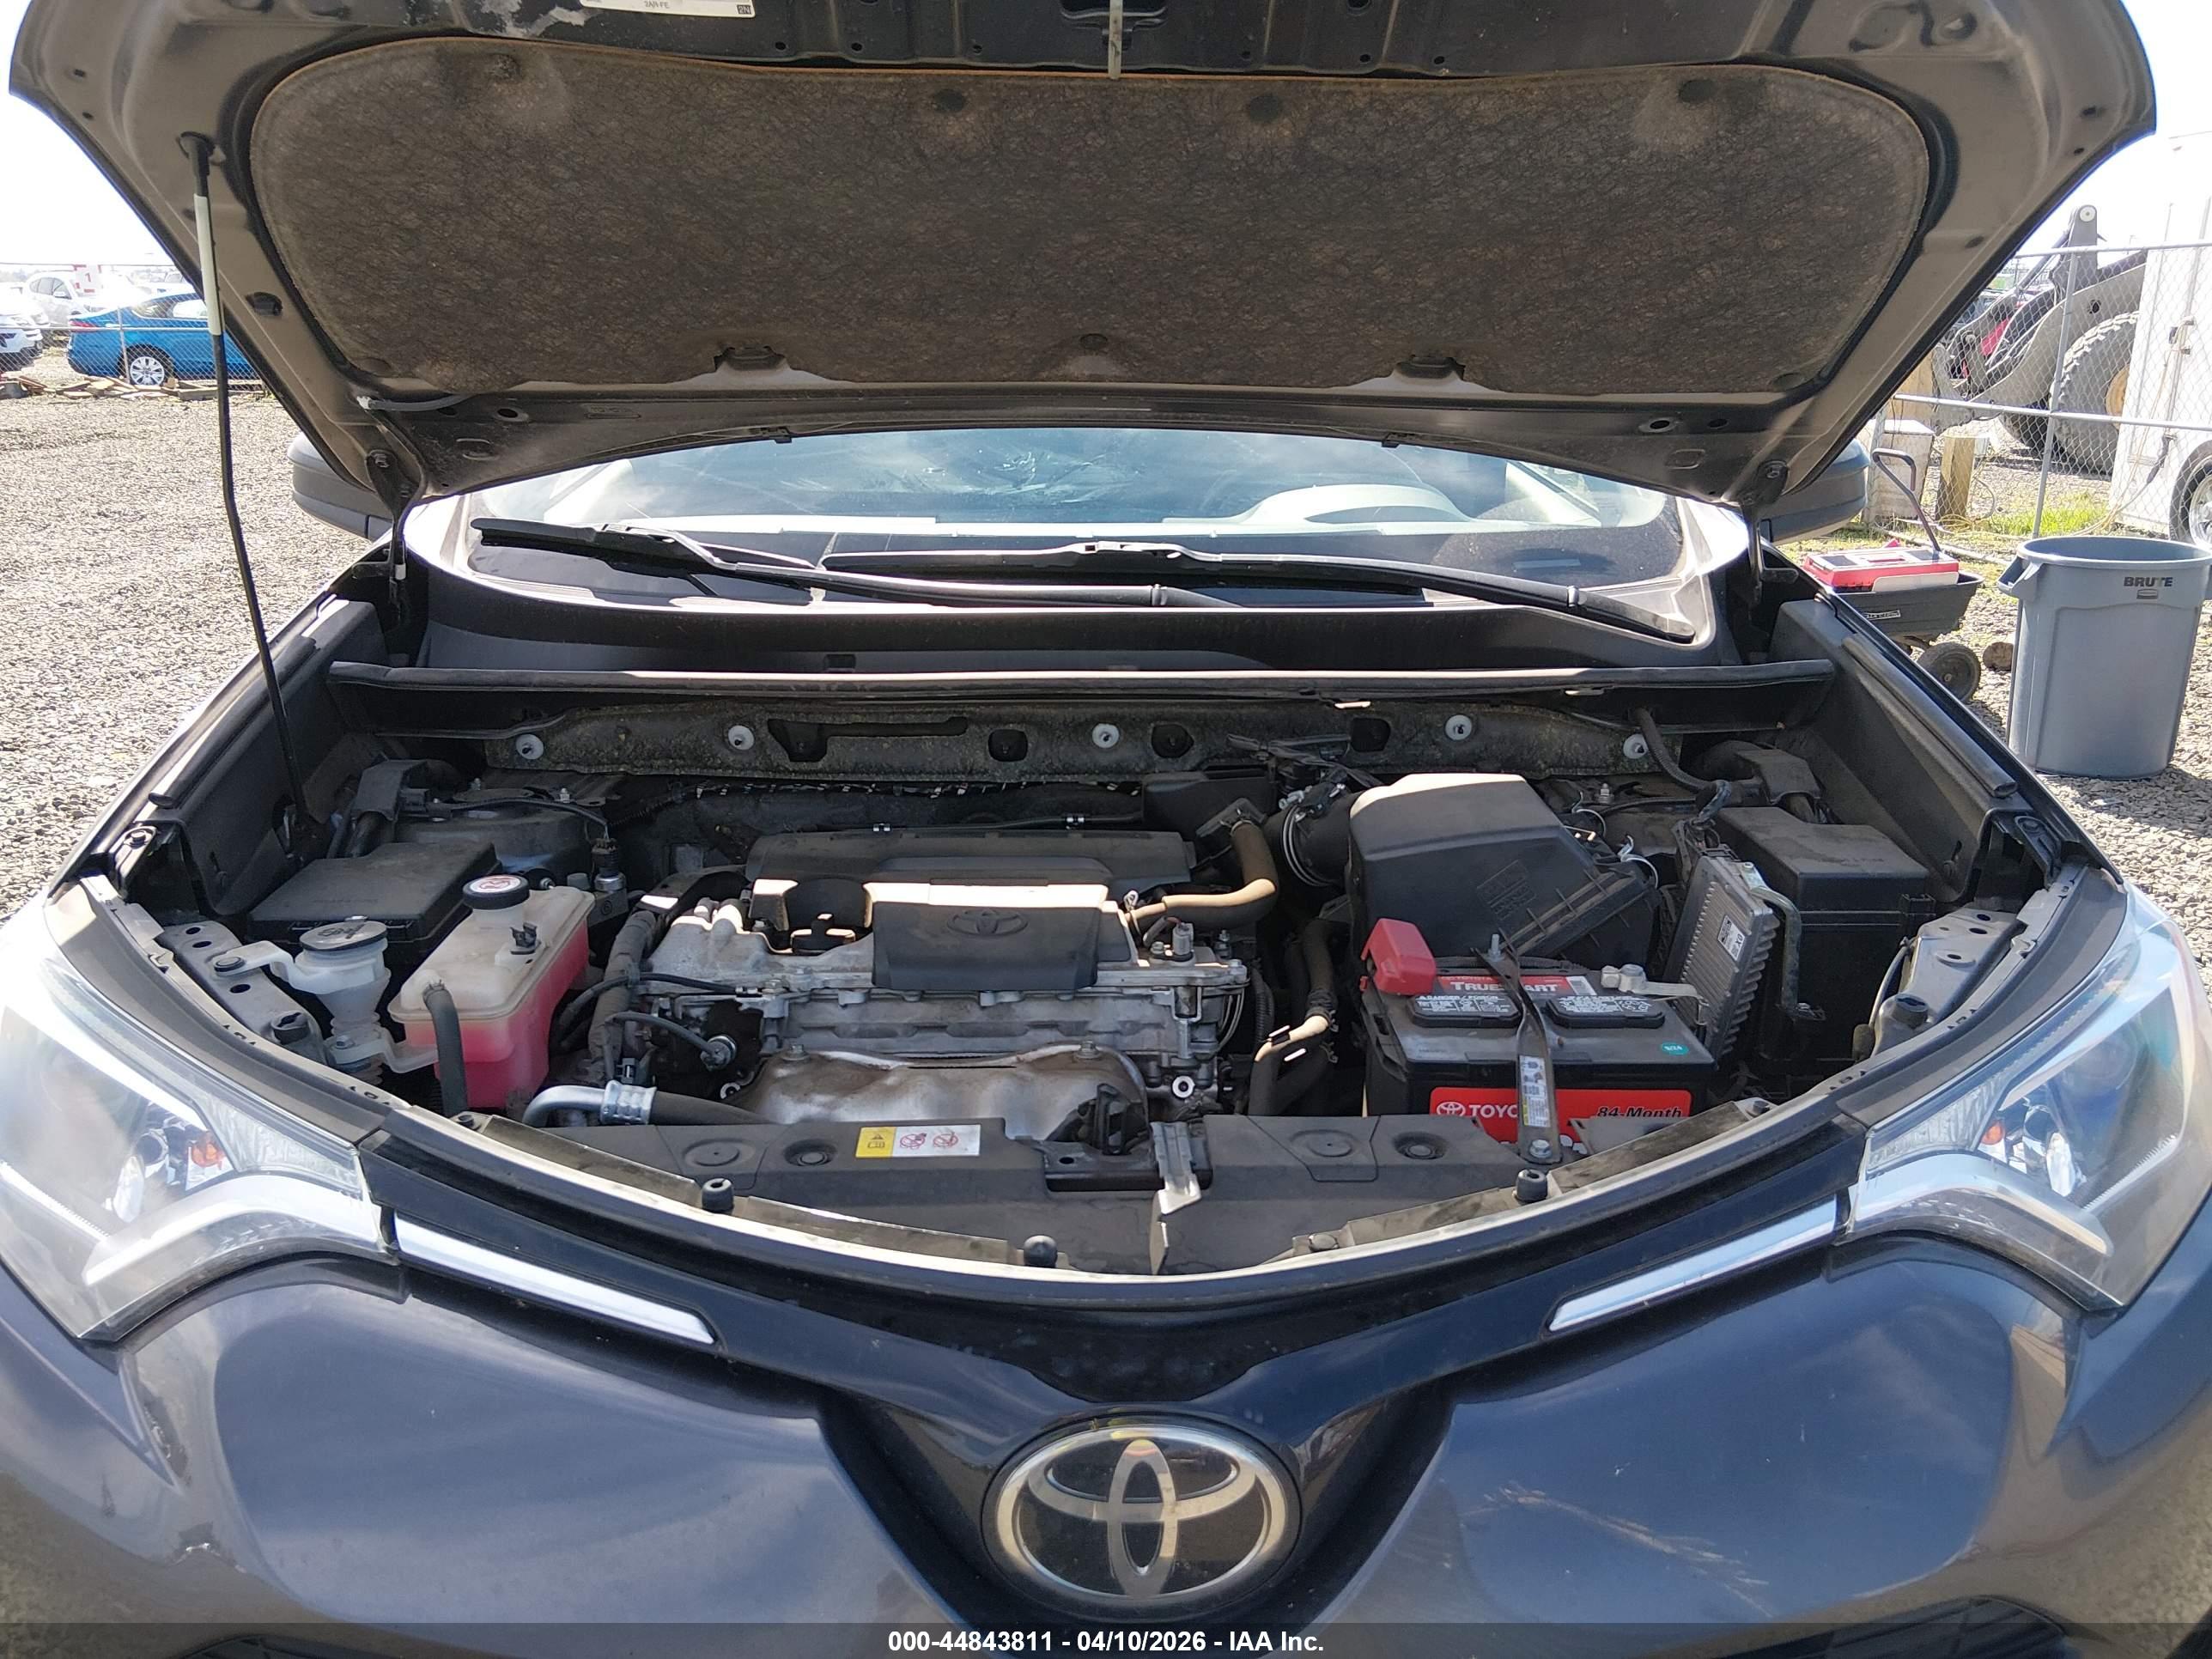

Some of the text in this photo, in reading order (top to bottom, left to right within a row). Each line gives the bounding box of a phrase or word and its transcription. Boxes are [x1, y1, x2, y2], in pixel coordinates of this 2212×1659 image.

[2124, 576, 2173, 587] BRUTE
[1450, 981, 1558, 991] TRUEART
[1468, 1104, 1518, 1118] TOYO
[1597, 1105, 1683, 1117] 84-Month
